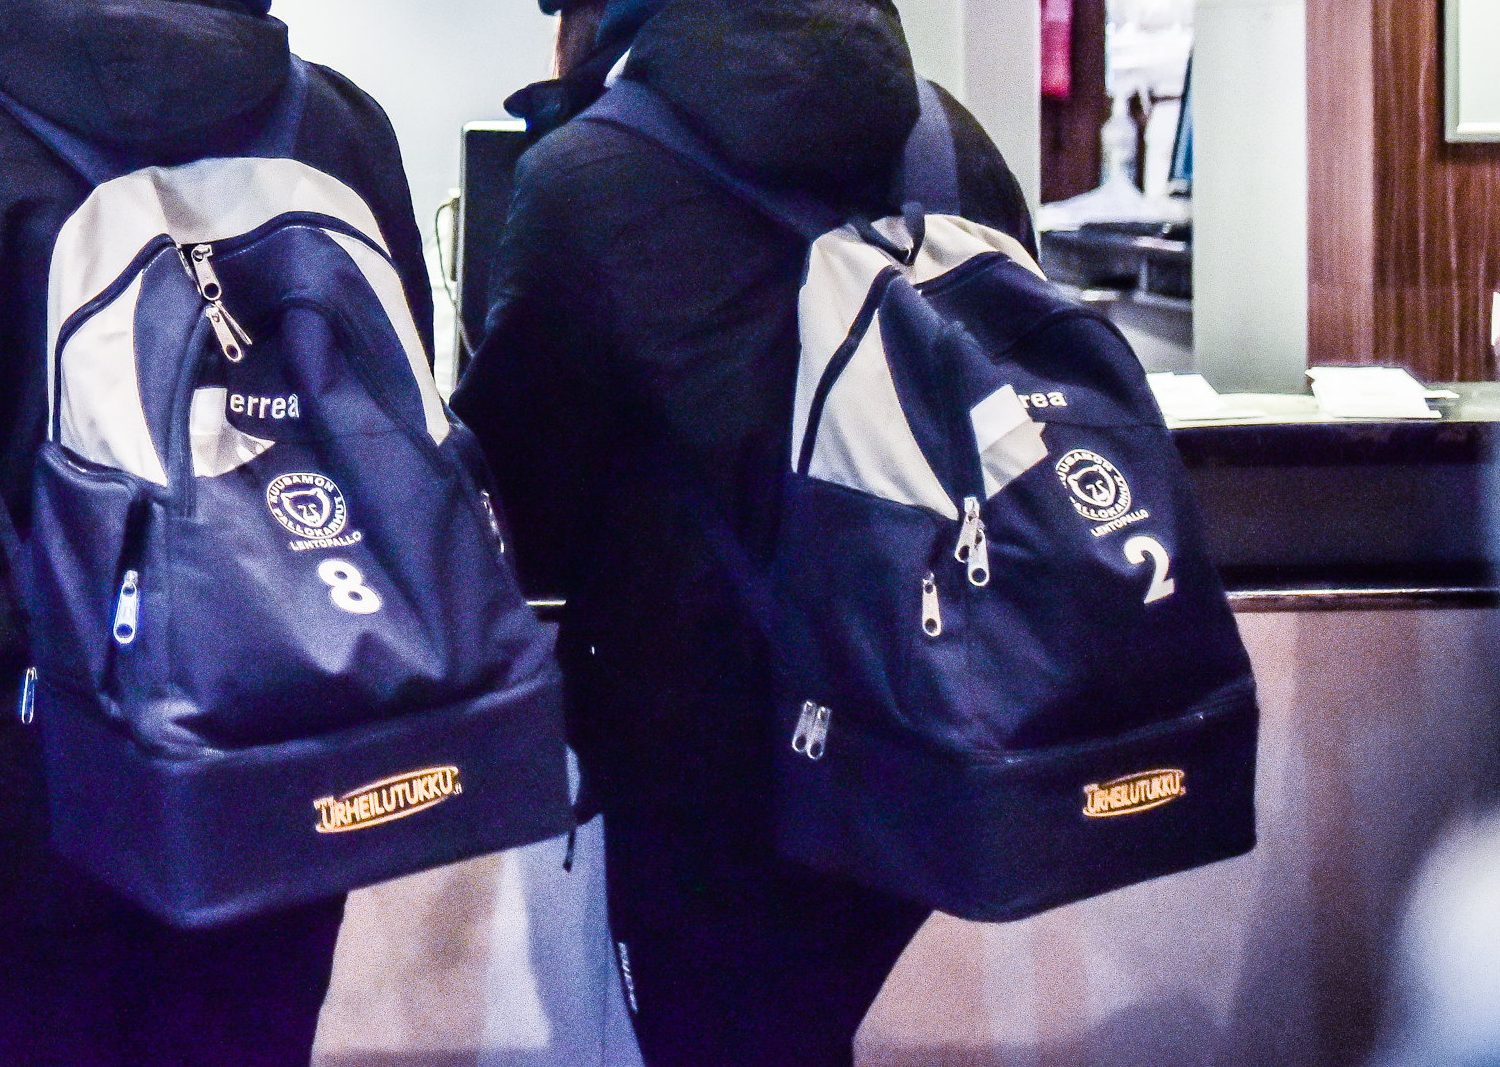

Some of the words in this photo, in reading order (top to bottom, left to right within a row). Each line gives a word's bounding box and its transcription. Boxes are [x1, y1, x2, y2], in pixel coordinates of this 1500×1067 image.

[1017, 391, 1068, 409] rea
[317, 559, 381, 614] 8
[1123, 535, 1175, 604] 2
